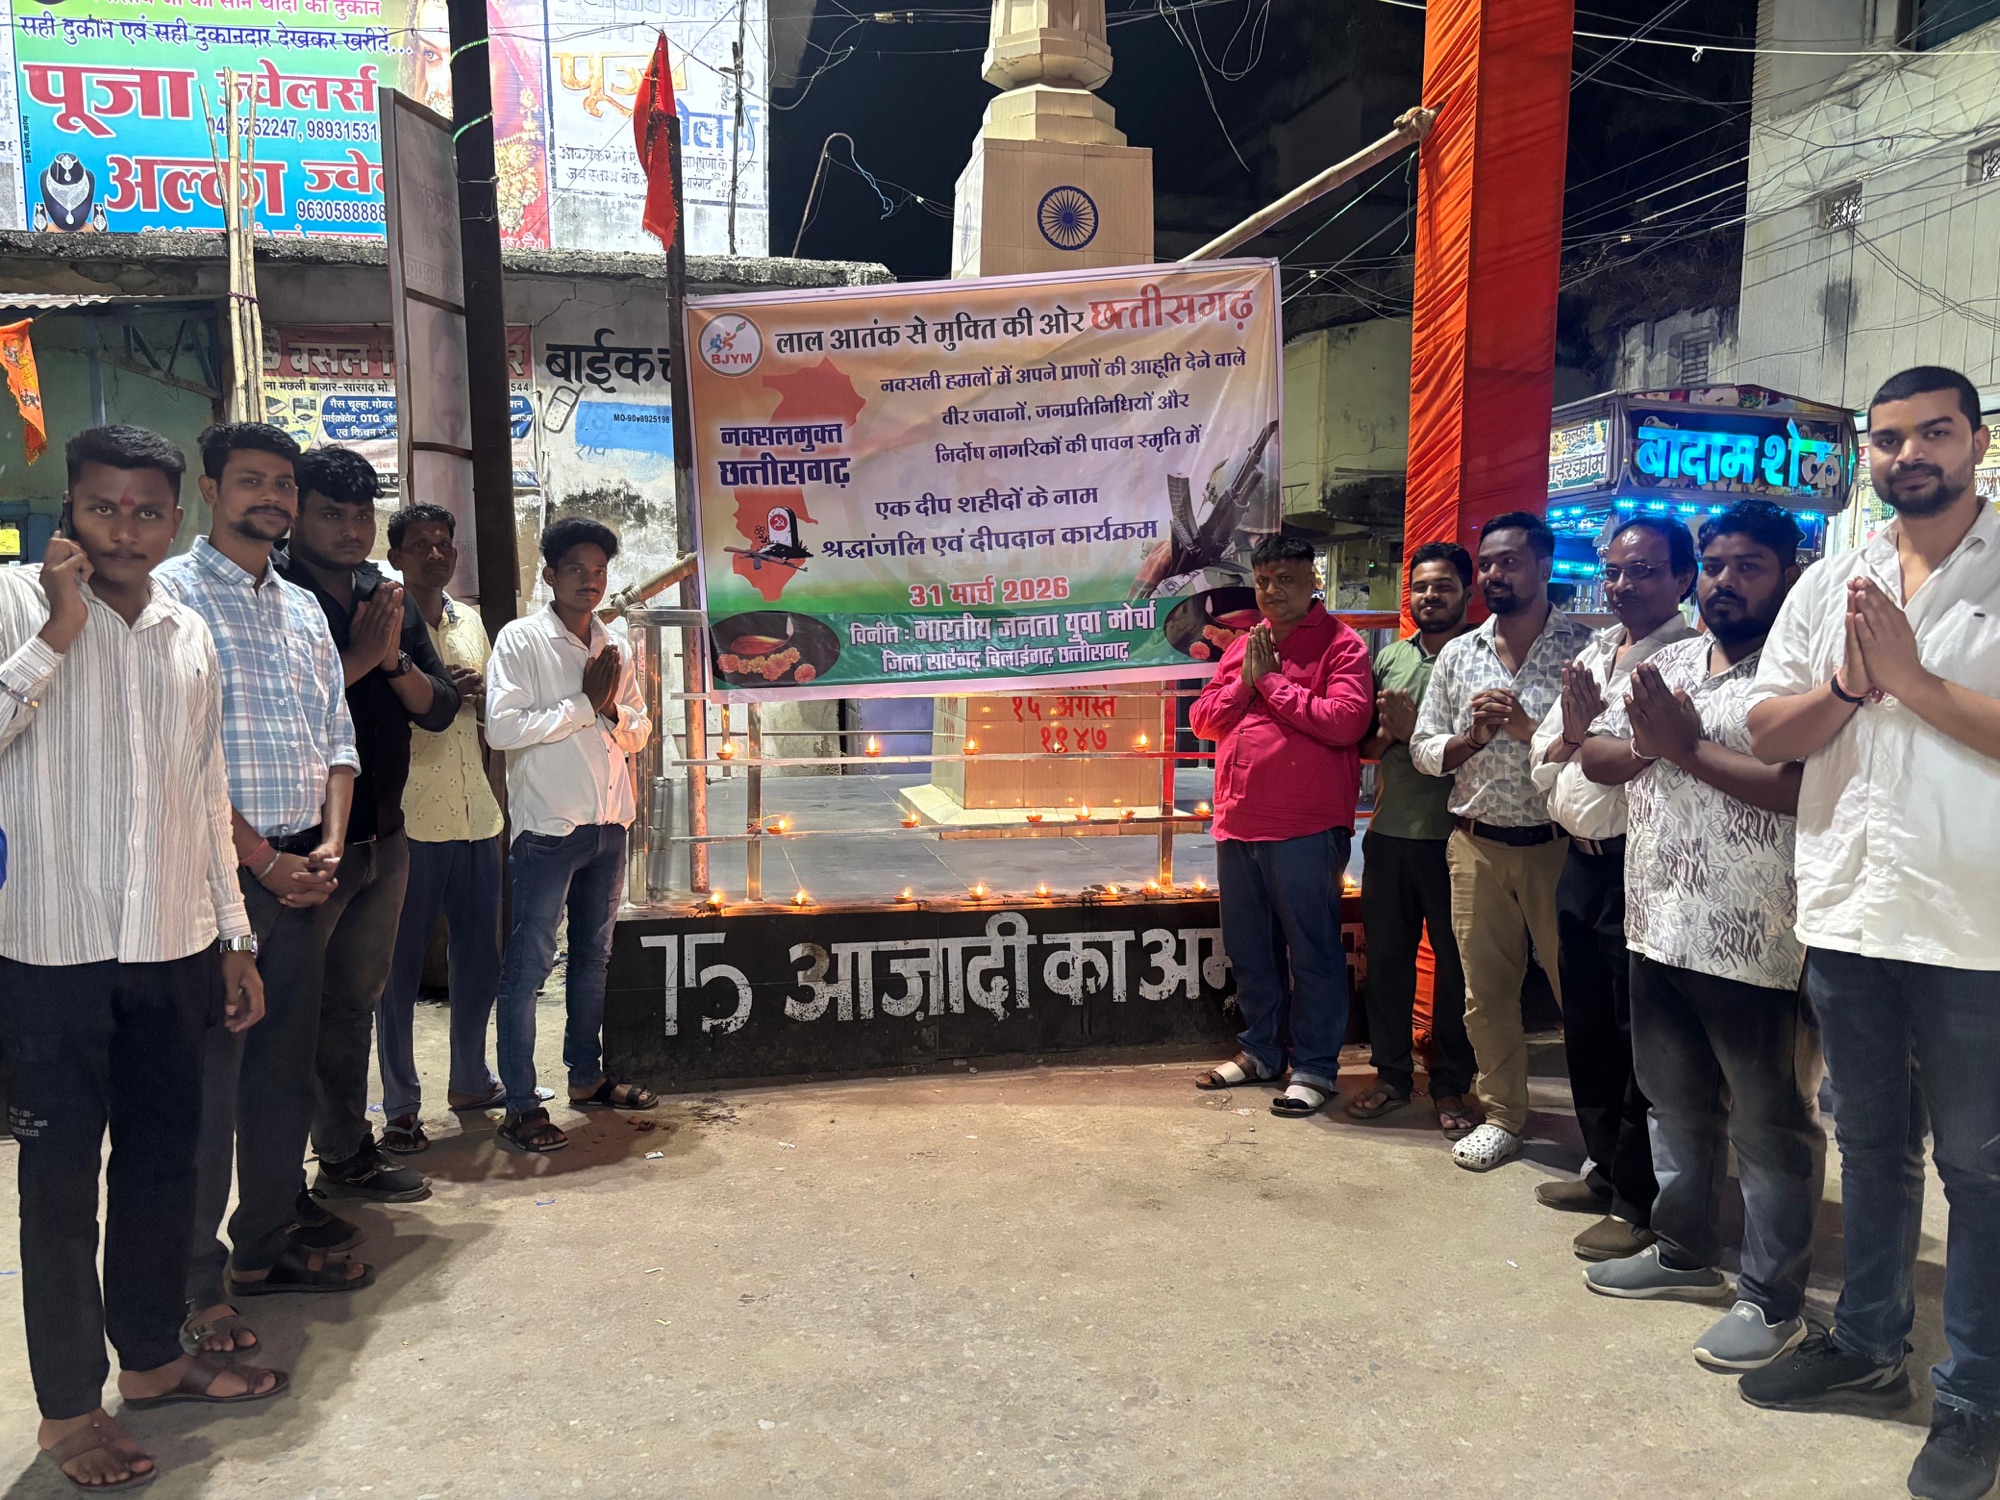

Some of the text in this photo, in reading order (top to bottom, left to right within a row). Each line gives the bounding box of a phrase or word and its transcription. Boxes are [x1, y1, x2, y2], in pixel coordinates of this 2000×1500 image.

[334, 0, 381, 20] दुकान
[19, 11, 55, 38] सही
[62, 19, 114, 44] दुकान
[119, 15, 147, 44] एवं
[153, 18, 188, 45] सही
[194, 26, 270, 51] दुकानदार
[277, 22, 337, 49] देखकर
[23, 64, 195, 136] पूजा
[216, 59, 377, 112] ज्वेलर्स
[106, 150, 386, 214] अल्का ज्वे
[775, 284, 1254, 353] लाल आतंक से मुक्ति की ओर छत्तीसगढ़
[711, 354, 753, 365] BJYM
[880, 346, 1246, 393] नक्सली हमलों में अपने प्राणों की आहूति देने वाले
[279, 379, 306, 391] मछली
[330, 397, 345, 408] गैस
[942, 389, 1190, 425] वीर जवानों, जनप्रतिनिधियों और
[336, 425, 349, 438] एवं
[351, 425, 376, 437] किचन
[719, 423, 843, 453] नक्सलमुक्त
[935, 424, 1203, 464] निर्दोष नागरिकों की पावन स्मृति में
[1637, 425, 1759, 484] बादाम
[1761, 416, 1842, 488] शेक
[718, 452, 851, 489] छत्तीसगढ़
[875, 485, 1099, 521] एक दीप शहीदों के नाम
[821, 516, 1158, 559] श्रद्धांजलि एवं दीपदान कार्यक्रम
[909, 575, 1070, 606] 31 मार्च 2026
[850, 623, 899, 645] विनीत
[913, 612, 991, 642] भारतीय
[997, 613, 1059, 640] जनता
[1063, 610, 1101, 642] युवा
[1106, 601, 1157, 632] मोर्चा
[882, 641, 1130, 672] जिला सारंगढ़ बिलाईगढ़ छत्तीसगढ़
[1011, 695, 1118, 722] १५ अगस्त
[1040, 726, 1108, 753] १९४७
[641, 934, 753, 1036] 75
[784, 912, 1037, 1022] आज़ादी
[1043, 930, 1136, 1003] का
